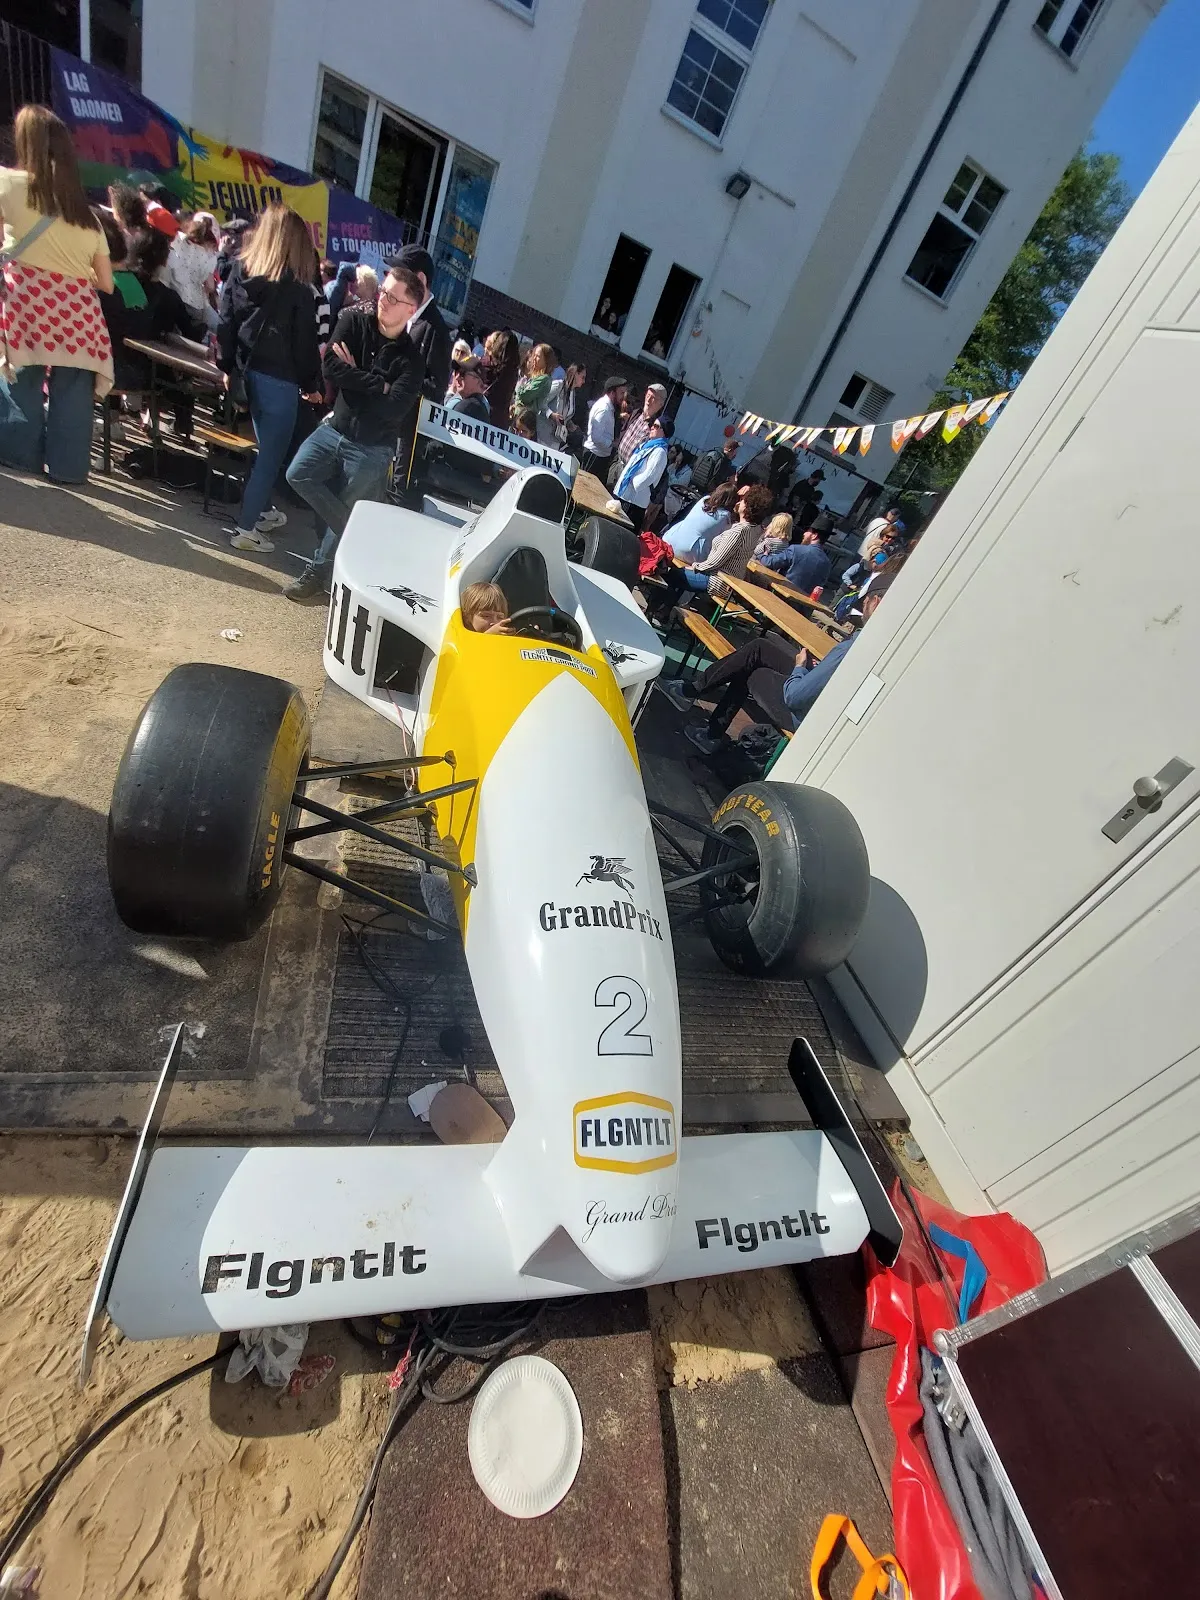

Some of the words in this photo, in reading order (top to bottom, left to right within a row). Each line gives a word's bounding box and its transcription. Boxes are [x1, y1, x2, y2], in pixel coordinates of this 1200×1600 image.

[63, 70, 91, 93] LAG
[69, 97, 124, 122] BAOMER
[711, 794, 780, 838] OODYEAR
[261, 811, 281, 889] EAGLE
[594, 975, 654, 1057] 2
[580, 1117, 672, 1148] FLGNTLT
[581, 1195, 651, 1243] Grand
